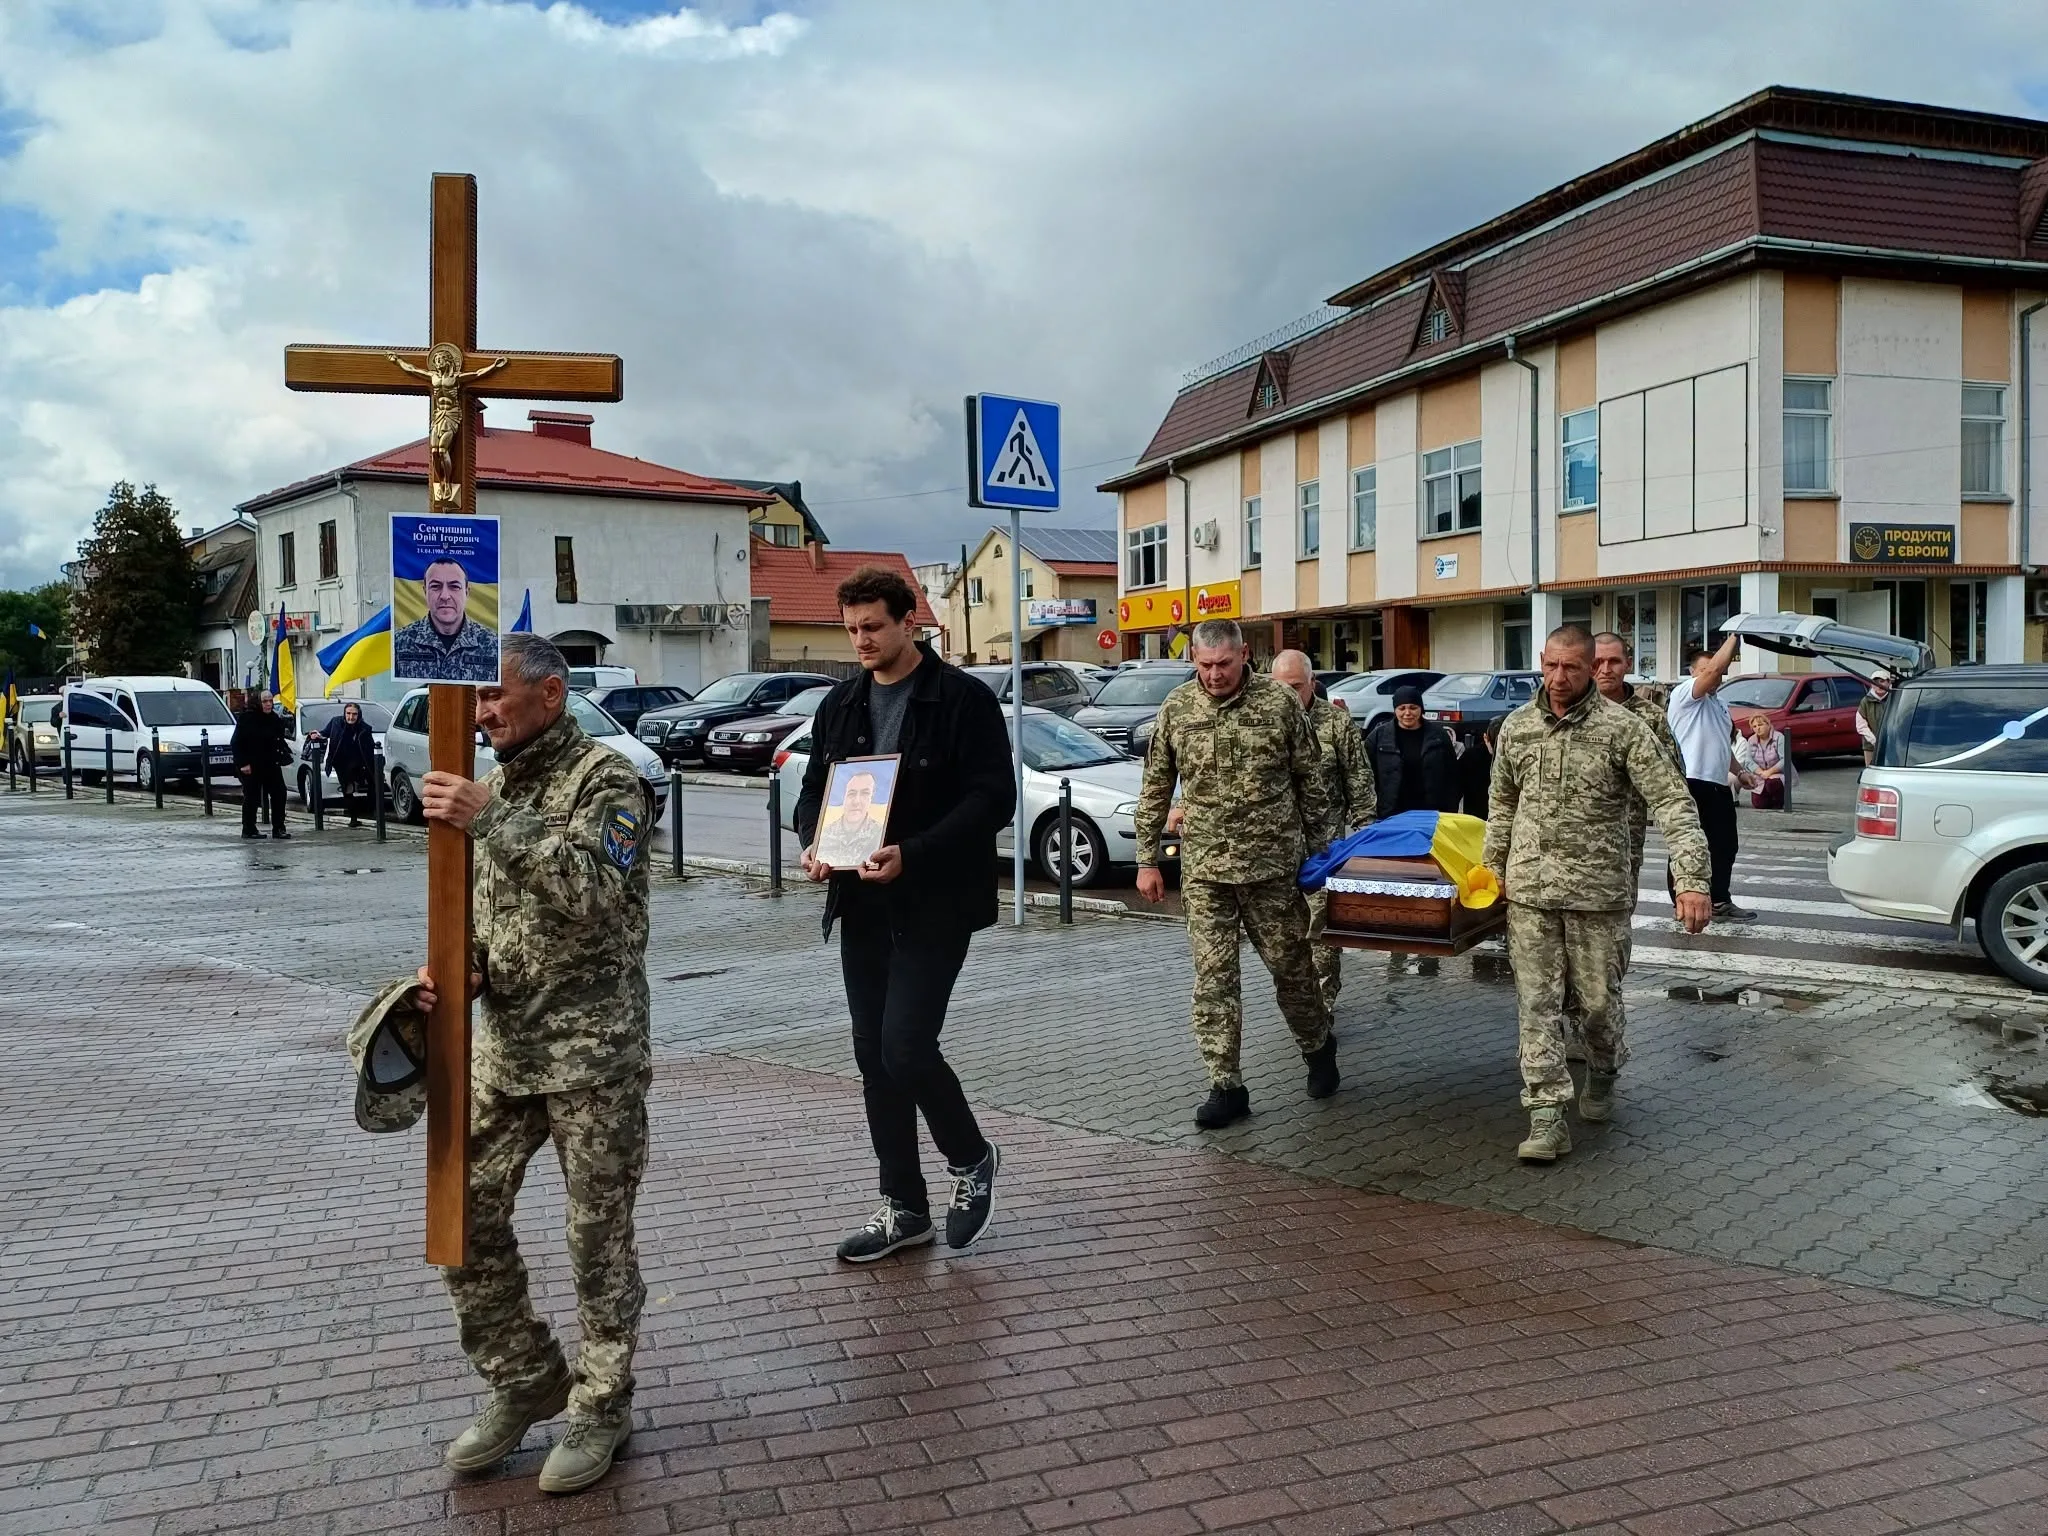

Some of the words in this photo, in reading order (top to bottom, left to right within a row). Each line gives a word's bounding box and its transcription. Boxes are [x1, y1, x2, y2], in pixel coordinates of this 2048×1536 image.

[418, 523, 472, 535] Семчишин
[413, 532, 437, 543] Юрій
[440, 533, 480, 544] Ігорович
[1884, 529, 1951, 543] ПРОДУКТИ
[1887, 545, 1895, 557] З
[1898, 545, 1949, 557] ЄВРОПИ
